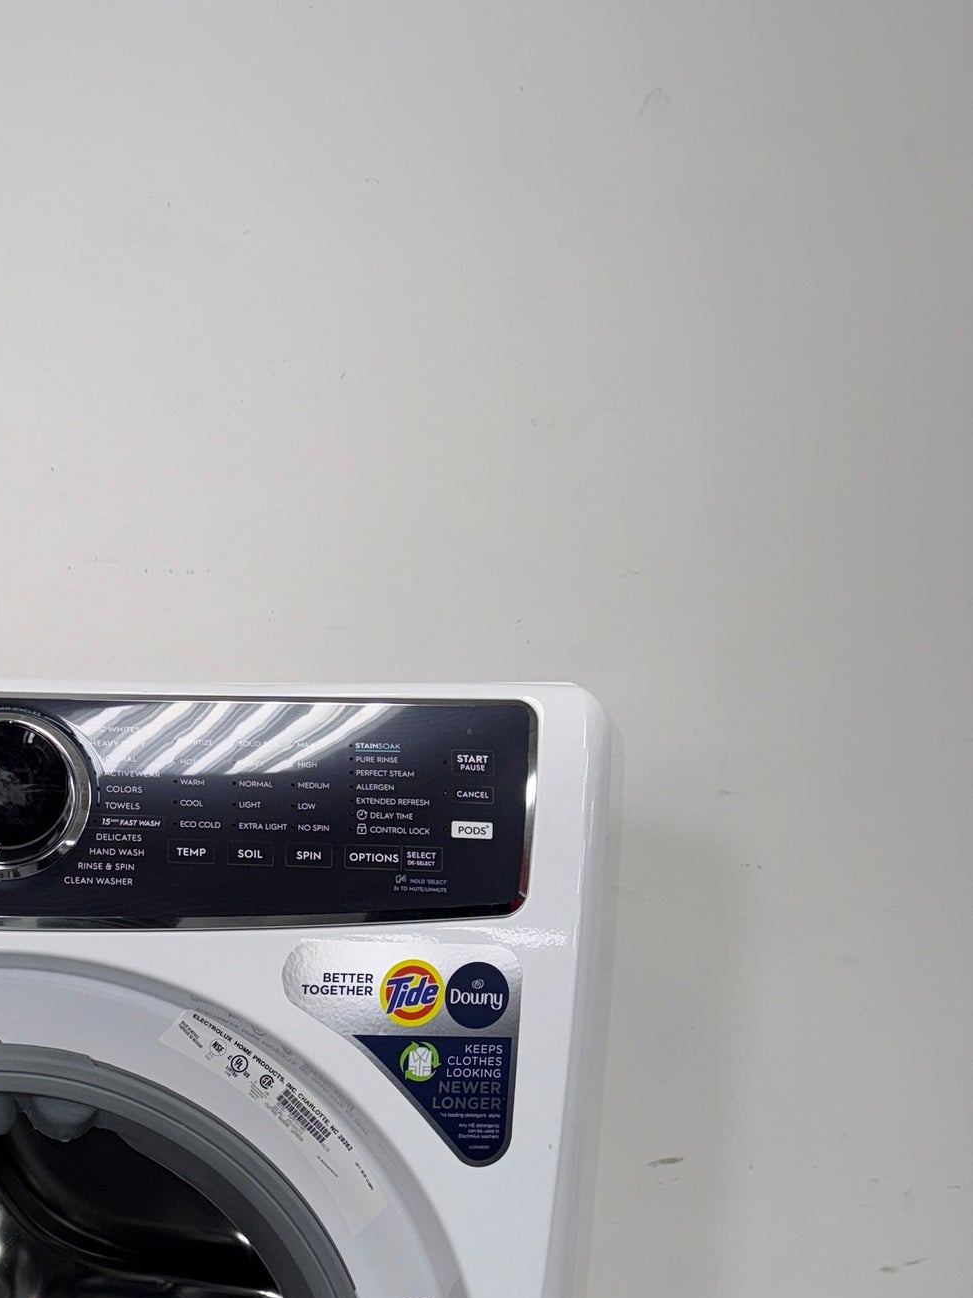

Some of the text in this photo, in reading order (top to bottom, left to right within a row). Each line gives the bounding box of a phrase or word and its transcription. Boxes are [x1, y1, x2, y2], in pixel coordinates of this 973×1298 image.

[108, 726, 140, 734] WHITES
[355, 742, 401, 750] STAINSOAK
[376, 756, 399, 764] RINSE
[456, 754, 488, 764] START
[460, 763, 486, 772] PAUSE
[104, 769, 161, 778] ACTIVEWEAR
[356, 769, 415, 778] PERFECT STEAM
[180, 778, 205, 786] WARM
[238, 780, 273, 789] NORMAL
[297, 781, 330, 790] MEDIUM
[106, 785, 142, 794] COLORS
[355, 783, 395, 791] ALLERGEN
[456, 790, 489, 799] CANCEL
[105, 801, 141, 811] TOWELS
[180, 799, 204, 807] COOL
[238, 801, 261, 810] LIGHT
[297, 802, 316, 810] LOW
[356, 797, 430, 807] EXTENDED REFRESH
[369, 812, 414, 820] DELAY TIME
[138, 819, 161, 827] WASH
[180, 820, 221, 829] ECO COLD
[238, 822, 288, 831] EXTRA LIGHT
[297, 823, 330, 832] NO SPIN
[369, 826, 431, 835] CONTROL LOCK
[96, 833, 142, 842] DELICATES
[89, 847, 145, 857] HAND WASH
[176, 848, 207, 857] TEMP
[237, 849, 263, 859] SOIL
[296, 850, 322, 860] SPIN
[406, 851, 436, 860] SELECT
[349, 852, 400, 863] OPTIONS
[77, 861, 135, 871] RINSE & SPIN
[63, 876, 133, 886] CLEAN WASHER
[323, 972, 374, 984] BETTER
[301, 984, 373, 997] TOGETHER
[385, 974, 440, 1015] Tide
[450, 988, 503, 1010] Downy
[211, 1040, 225, 1053] NSF
[464, 1044, 503, 1054] KEEPS
[447, 1056, 502, 1066] CLOTHES
[446, 1068, 502, 1079] LOOKING
[192, 1013, 233, 1042] ELECTROLUX
[233, 1041, 252, 1056] HOME
[252, 1055, 285, 1084] PRODUCTS,
[329, 1125, 339, 1135] NC
[337, 1134, 353, 1151] 28262
[438, 1081, 502, 1095] NEWER
